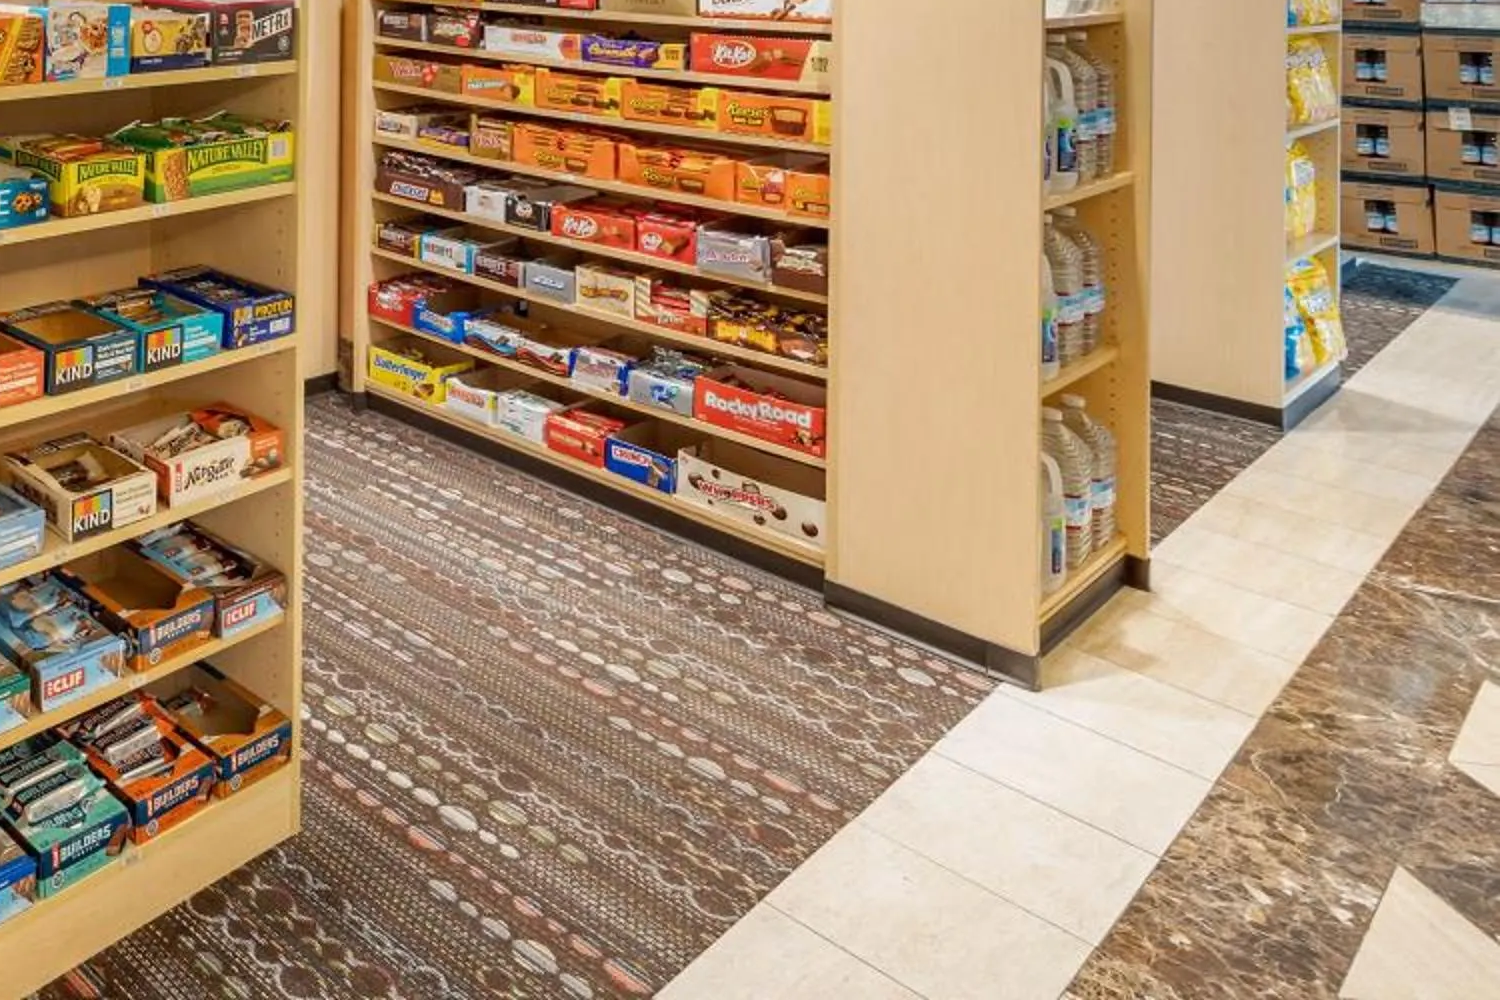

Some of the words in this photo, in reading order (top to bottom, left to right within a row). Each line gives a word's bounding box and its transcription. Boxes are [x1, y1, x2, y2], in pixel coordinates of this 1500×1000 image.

[230, 139, 267, 163] VALLEY
[147, 343, 181, 365] KIND
[55, 362, 94, 386] KIND
[73, 509, 111, 533] KIND
[231, 601, 257, 623] CLIF
[54, 669, 85, 695] CLIF
[60, 823, 112, 862] BUILDERS
